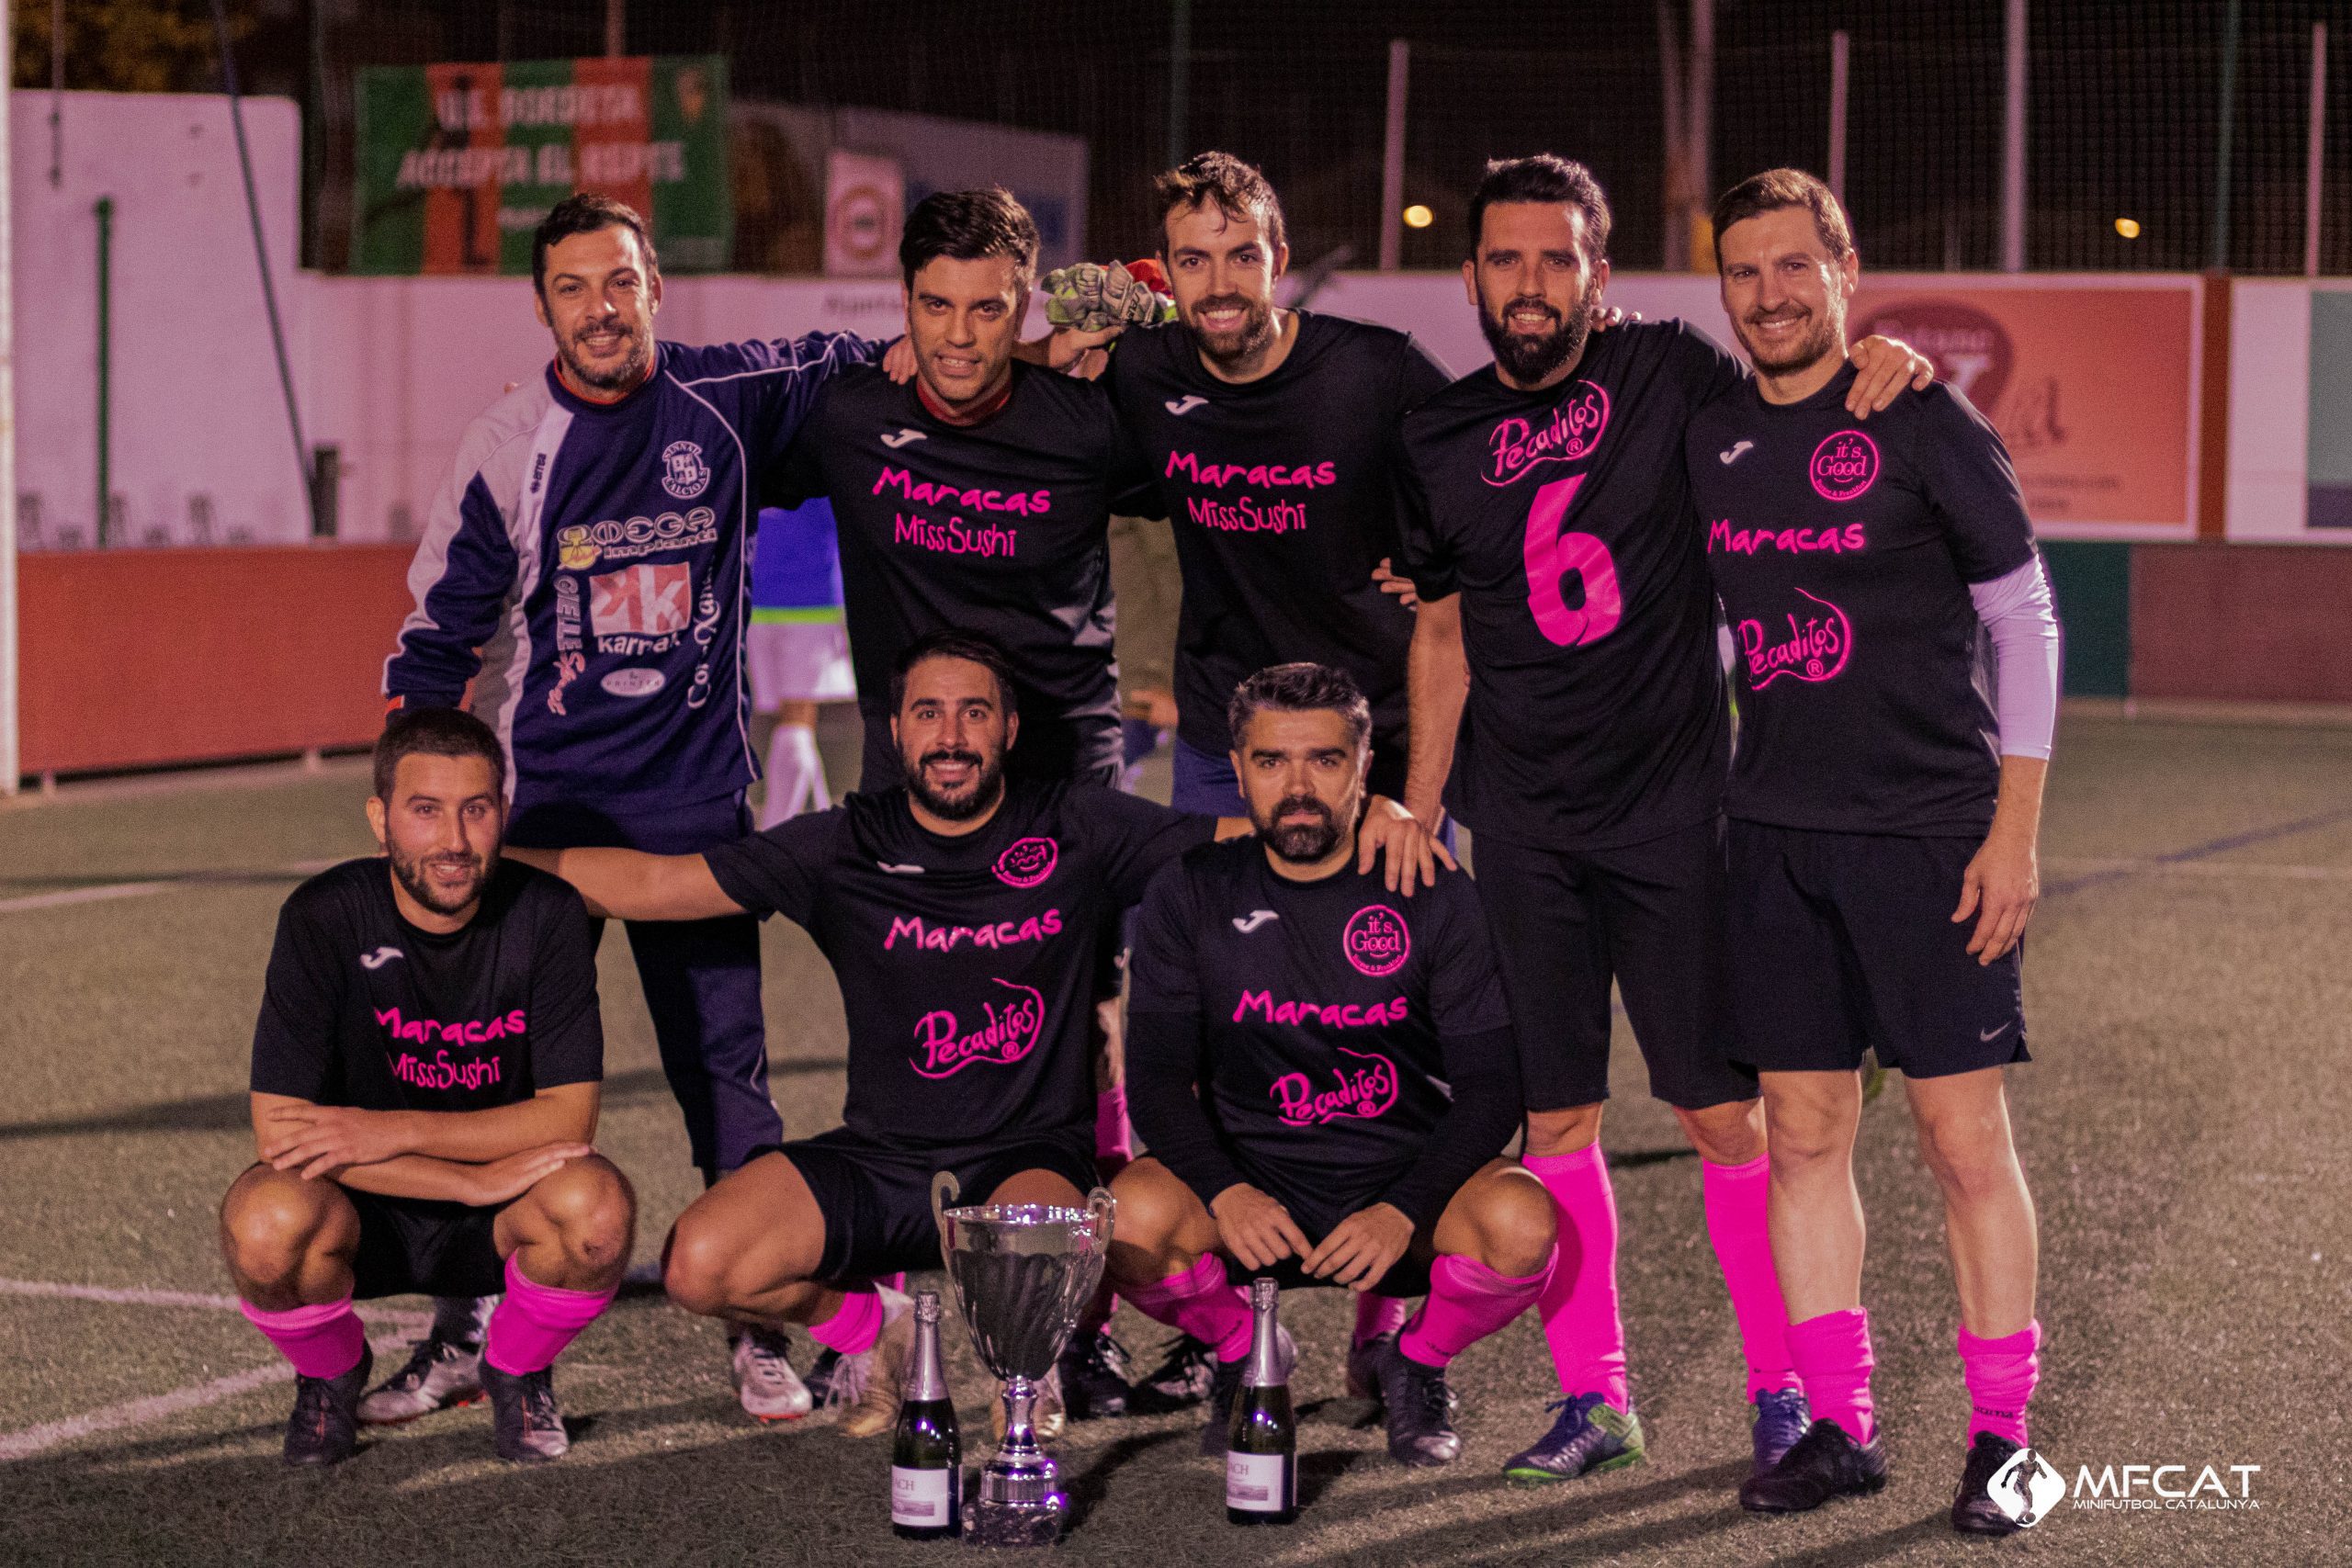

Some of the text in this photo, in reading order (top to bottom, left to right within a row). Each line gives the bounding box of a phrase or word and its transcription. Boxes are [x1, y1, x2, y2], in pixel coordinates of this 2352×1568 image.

[1488, 394, 1600, 478] Pecaditos
[1835, 438, 1862, 458] it's
[1164, 450, 1337, 490] Maracas
[1816, 455, 1867, 476] Good
[873, 466, 1051, 516] Maracas
[1707, 518, 1866, 555] Maracas
[1523, 473, 1622, 647] 6
[1737, 613, 1840, 683] Pecaditos
[884, 908, 1063, 953] Maracas
[1351, 930, 1401, 952] Good
[1367, 912, 1394, 934] it's
[373, 1007, 526, 1046] Maracas
[1232, 989, 1408, 1030] Maracas
[914, 999, 1035, 1069] Pecaditos
[1270, 1065, 1390, 1119] Pecaditos
